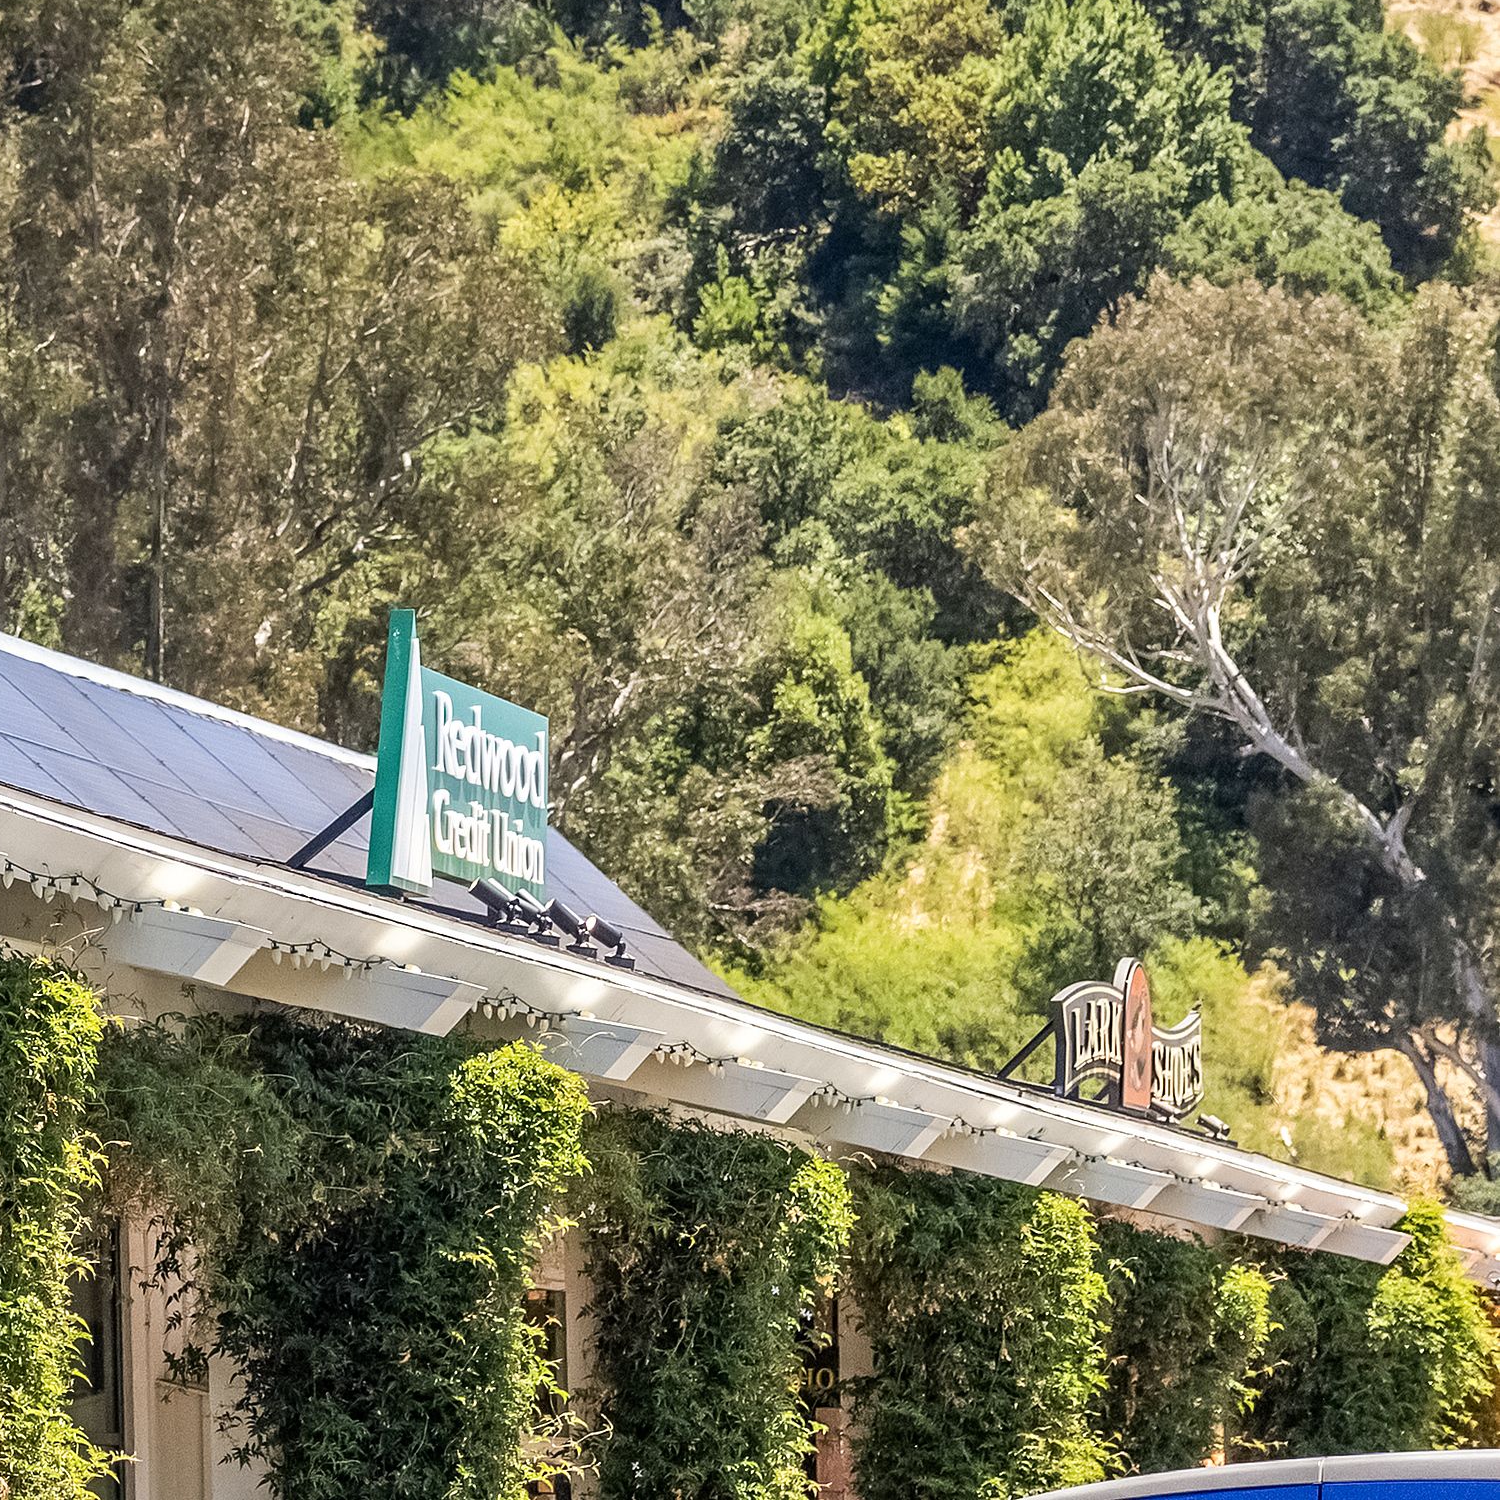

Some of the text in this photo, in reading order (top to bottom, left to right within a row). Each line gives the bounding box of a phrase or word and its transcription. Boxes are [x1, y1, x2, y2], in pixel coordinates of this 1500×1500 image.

[432, 690, 546, 809] Redwood
[433, 789, 544, 885] Credit Union
[1072, 999, 1123, 1070] LARK
[1152, 1036, 1202, 1106] SHOES
